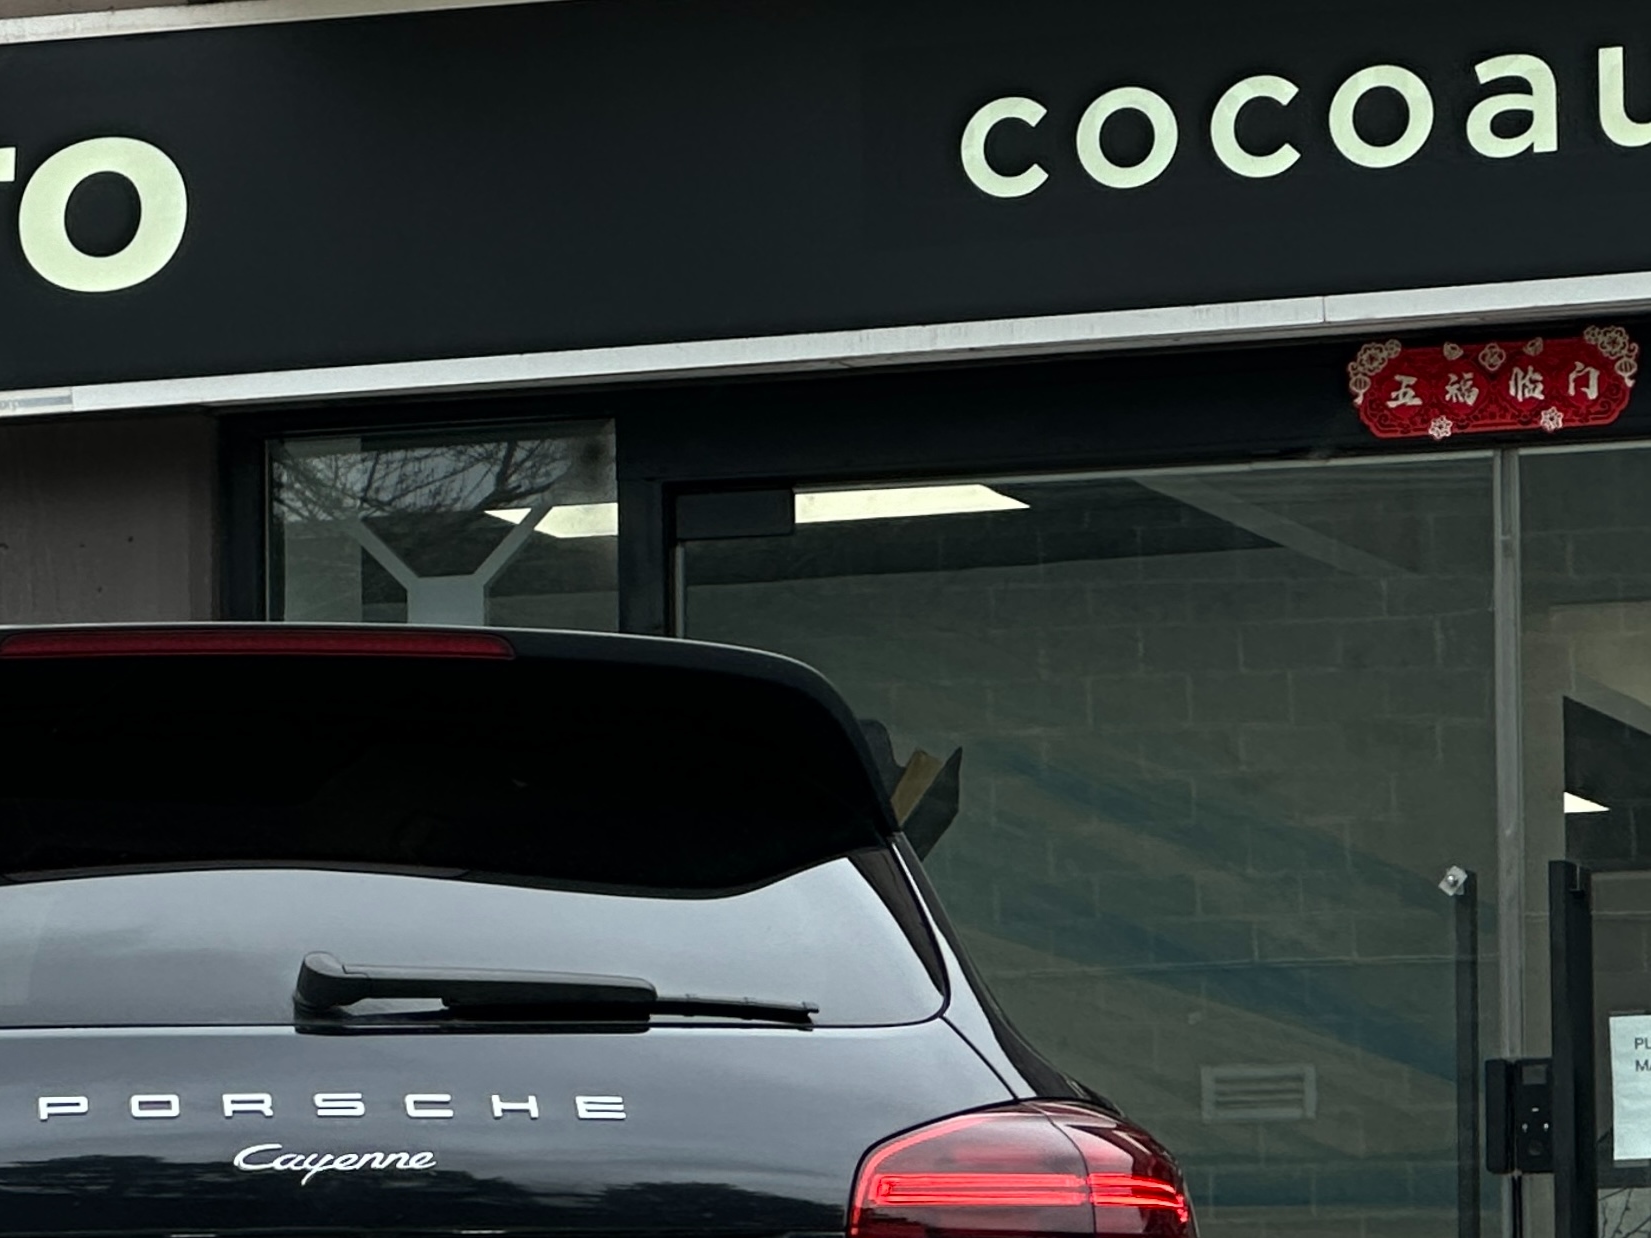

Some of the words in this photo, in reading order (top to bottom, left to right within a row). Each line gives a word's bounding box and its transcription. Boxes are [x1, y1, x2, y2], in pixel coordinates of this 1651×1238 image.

[1386, 361, 1600, 409] 五福临门
[37, 1092, 628, 1121] PORSCHE
[233, 1143, 437, 1186] Cayenne
